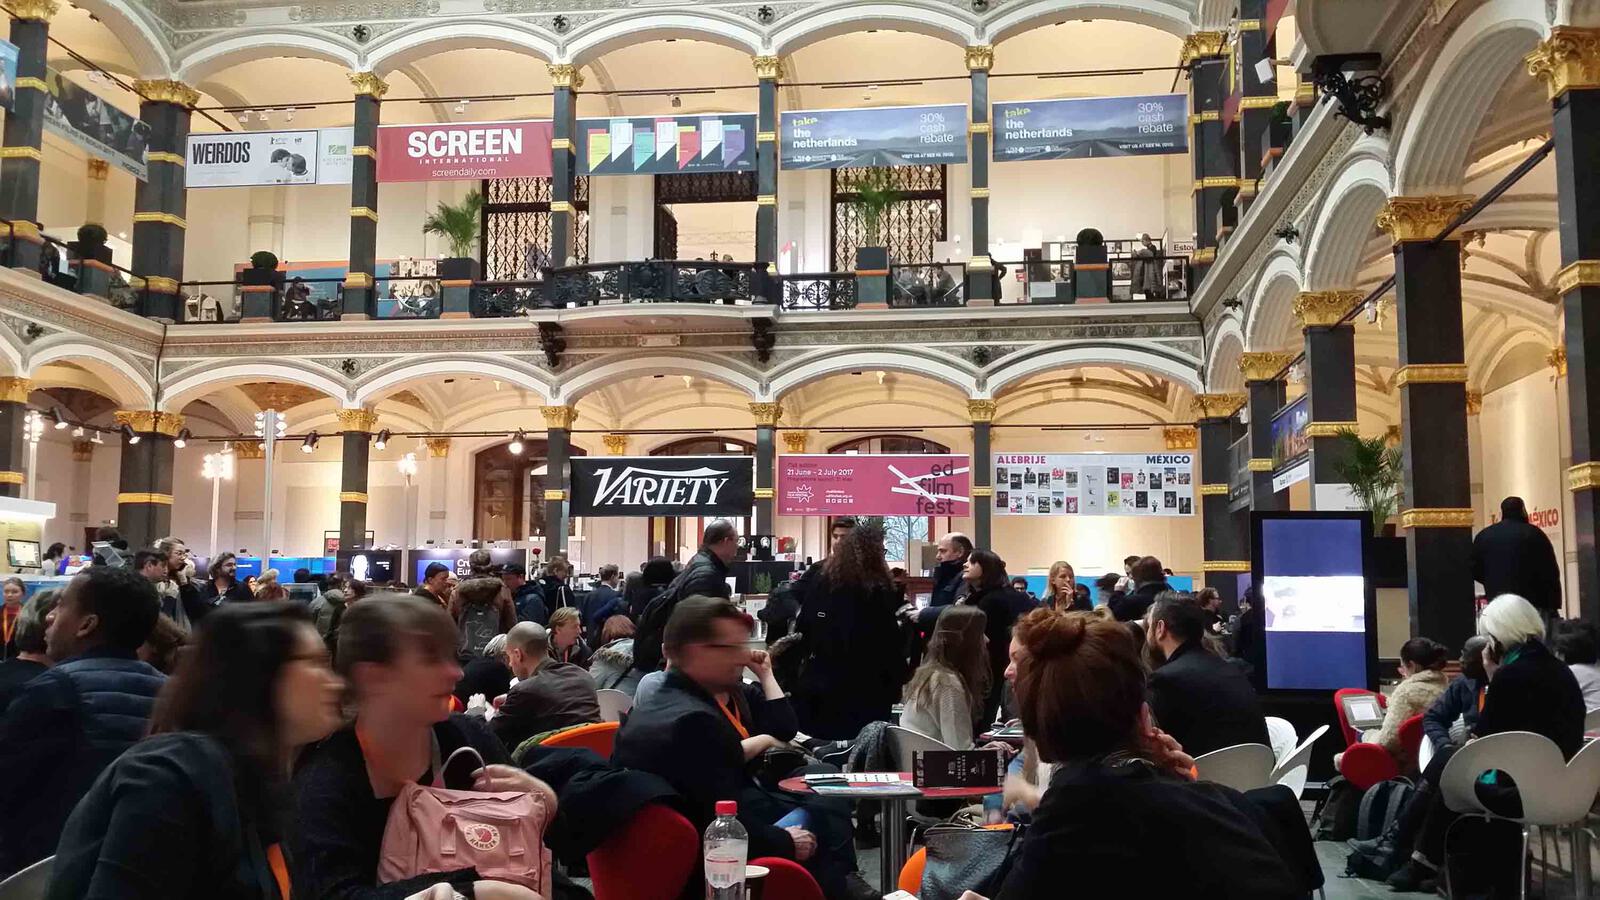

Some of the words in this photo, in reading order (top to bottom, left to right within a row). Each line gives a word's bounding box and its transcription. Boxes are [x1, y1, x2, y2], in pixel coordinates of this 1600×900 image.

[1005, 107, 1032, 118] take
[1137, 102, 1164, 113] 30%
[793, 116, 818, 127] take
[920, 112, 945, 123] 30%
[1138, 112, 1165, 123] cash
[920, 123, 945, 133] cash
[1005, 119, 1025, 129] the
[1138, 123, 1174, 134] rebate
[793, 128, 812, 138] the
[920, 133, 954, 143] rebate
[1005, 127, 1073, 140] netherlands
[407, 128, 523, 158] SCREEN
[793, 136, 858, 148] netherlands
[192, 141, 251, 165] WEIRDOS
[419, 157, 509, 165] INTERNATIONAL
[432, 167, 497, 178] screendaily.com
[997, 455, 1046, 464] ALEBRIJE
[1146, 454, 1191, 464] MÉXICO
[823, 468, 837, 477] July
[931, 459, 954, 476] ed
[592, 466, 730, 507] VARIETY
[919, 477, 954, 496] film
[916, 496, 954, 514] fest
